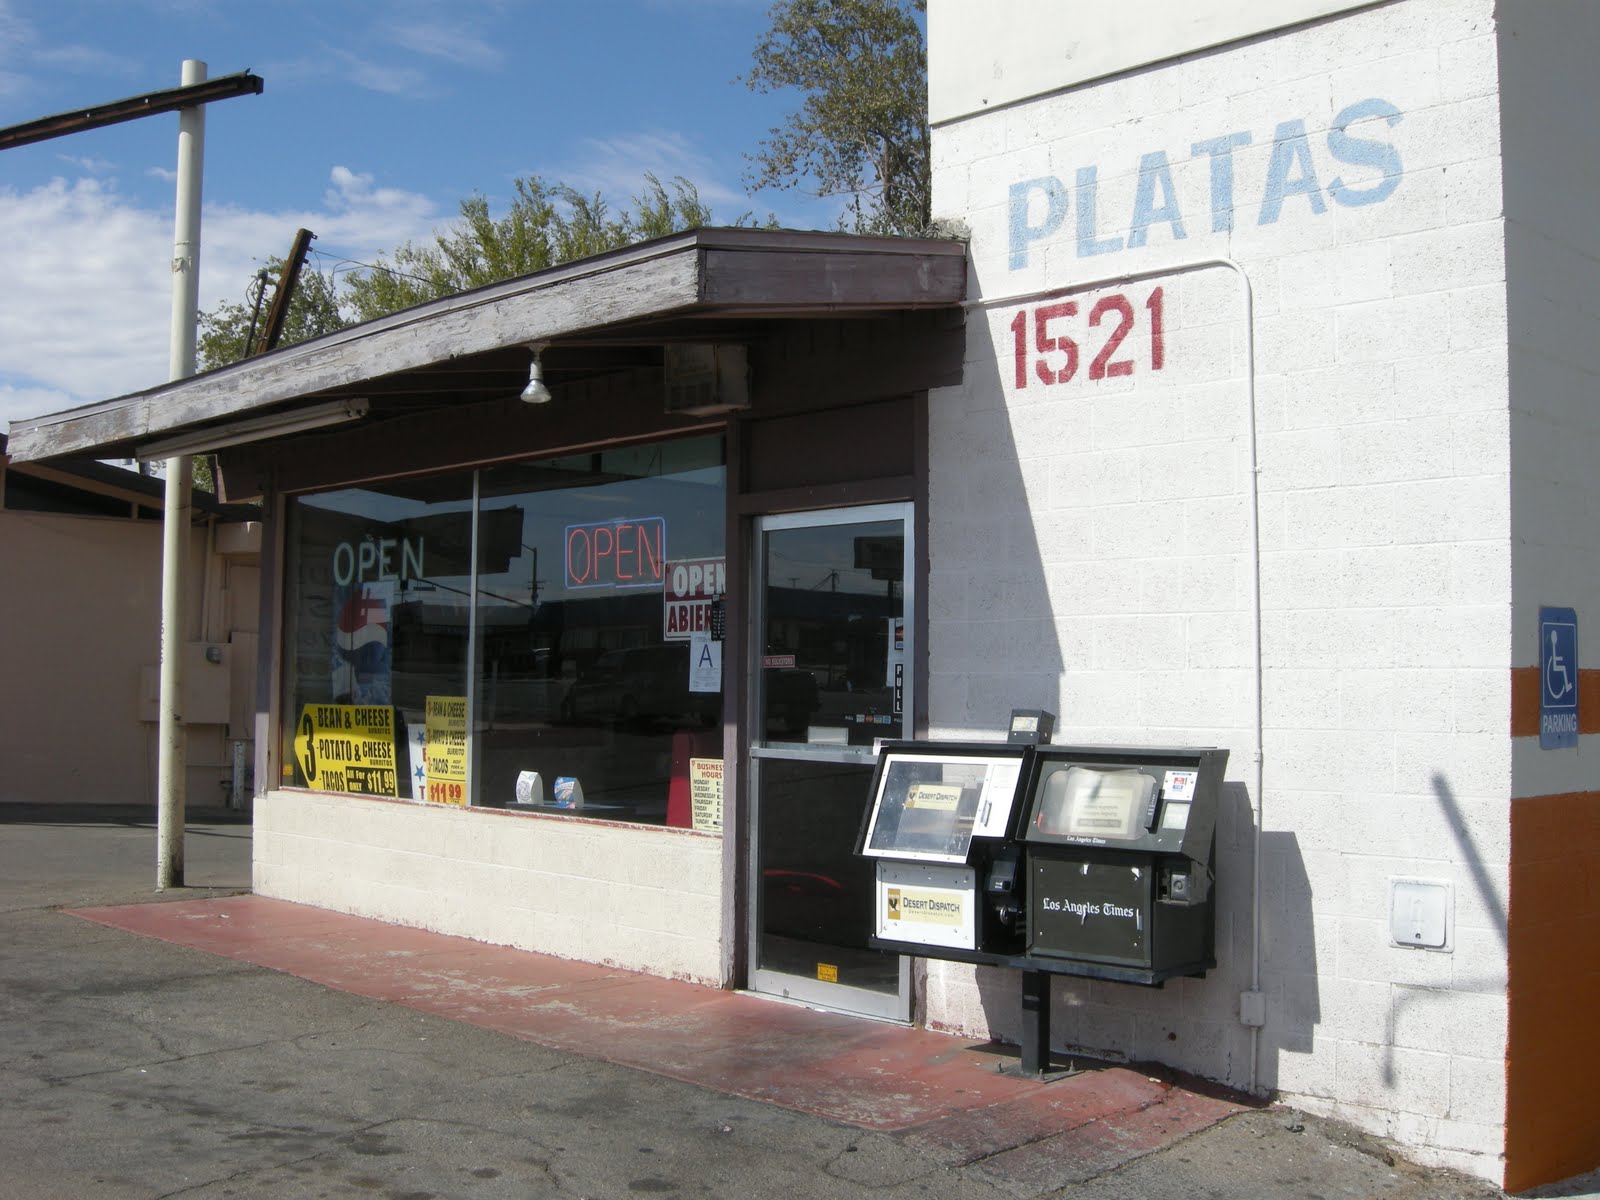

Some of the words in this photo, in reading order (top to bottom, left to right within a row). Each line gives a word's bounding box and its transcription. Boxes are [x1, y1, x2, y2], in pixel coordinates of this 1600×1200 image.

[1008, 97, 1404, 271] PLATAS
[1010, 285, 1166, 389] 1521
[333, 536, 424, 586] OPEN
[568, 524, 661, 584] OPEN
[667, 604, 713, 633] ABIER
[698, 644, 713, 667] A
[345, 711, 352, 729] &
[355, 708, 390, 727] CHEESE
[1543, 713, 1577, 733] PARKING
[303, 713, 316, 782] 3
[354, 744, 361, 762] &
[362, 741, 391, 759] CHEESE
[447, 747, 464, 756] BURRITO
[697, 763, 724, 771] BUSINES
[701, 771, 722, 779] HOURS
[367, 770, 394, 793] $11.99
[903, 897, 927, 909] DESERT
[928, 899, 960, 913] DISPATCH
[1043, 897, 1060, 910] Los
[1062, 899, 1100, 915] Angeles
[1103, 902, 1134, 918] Times
